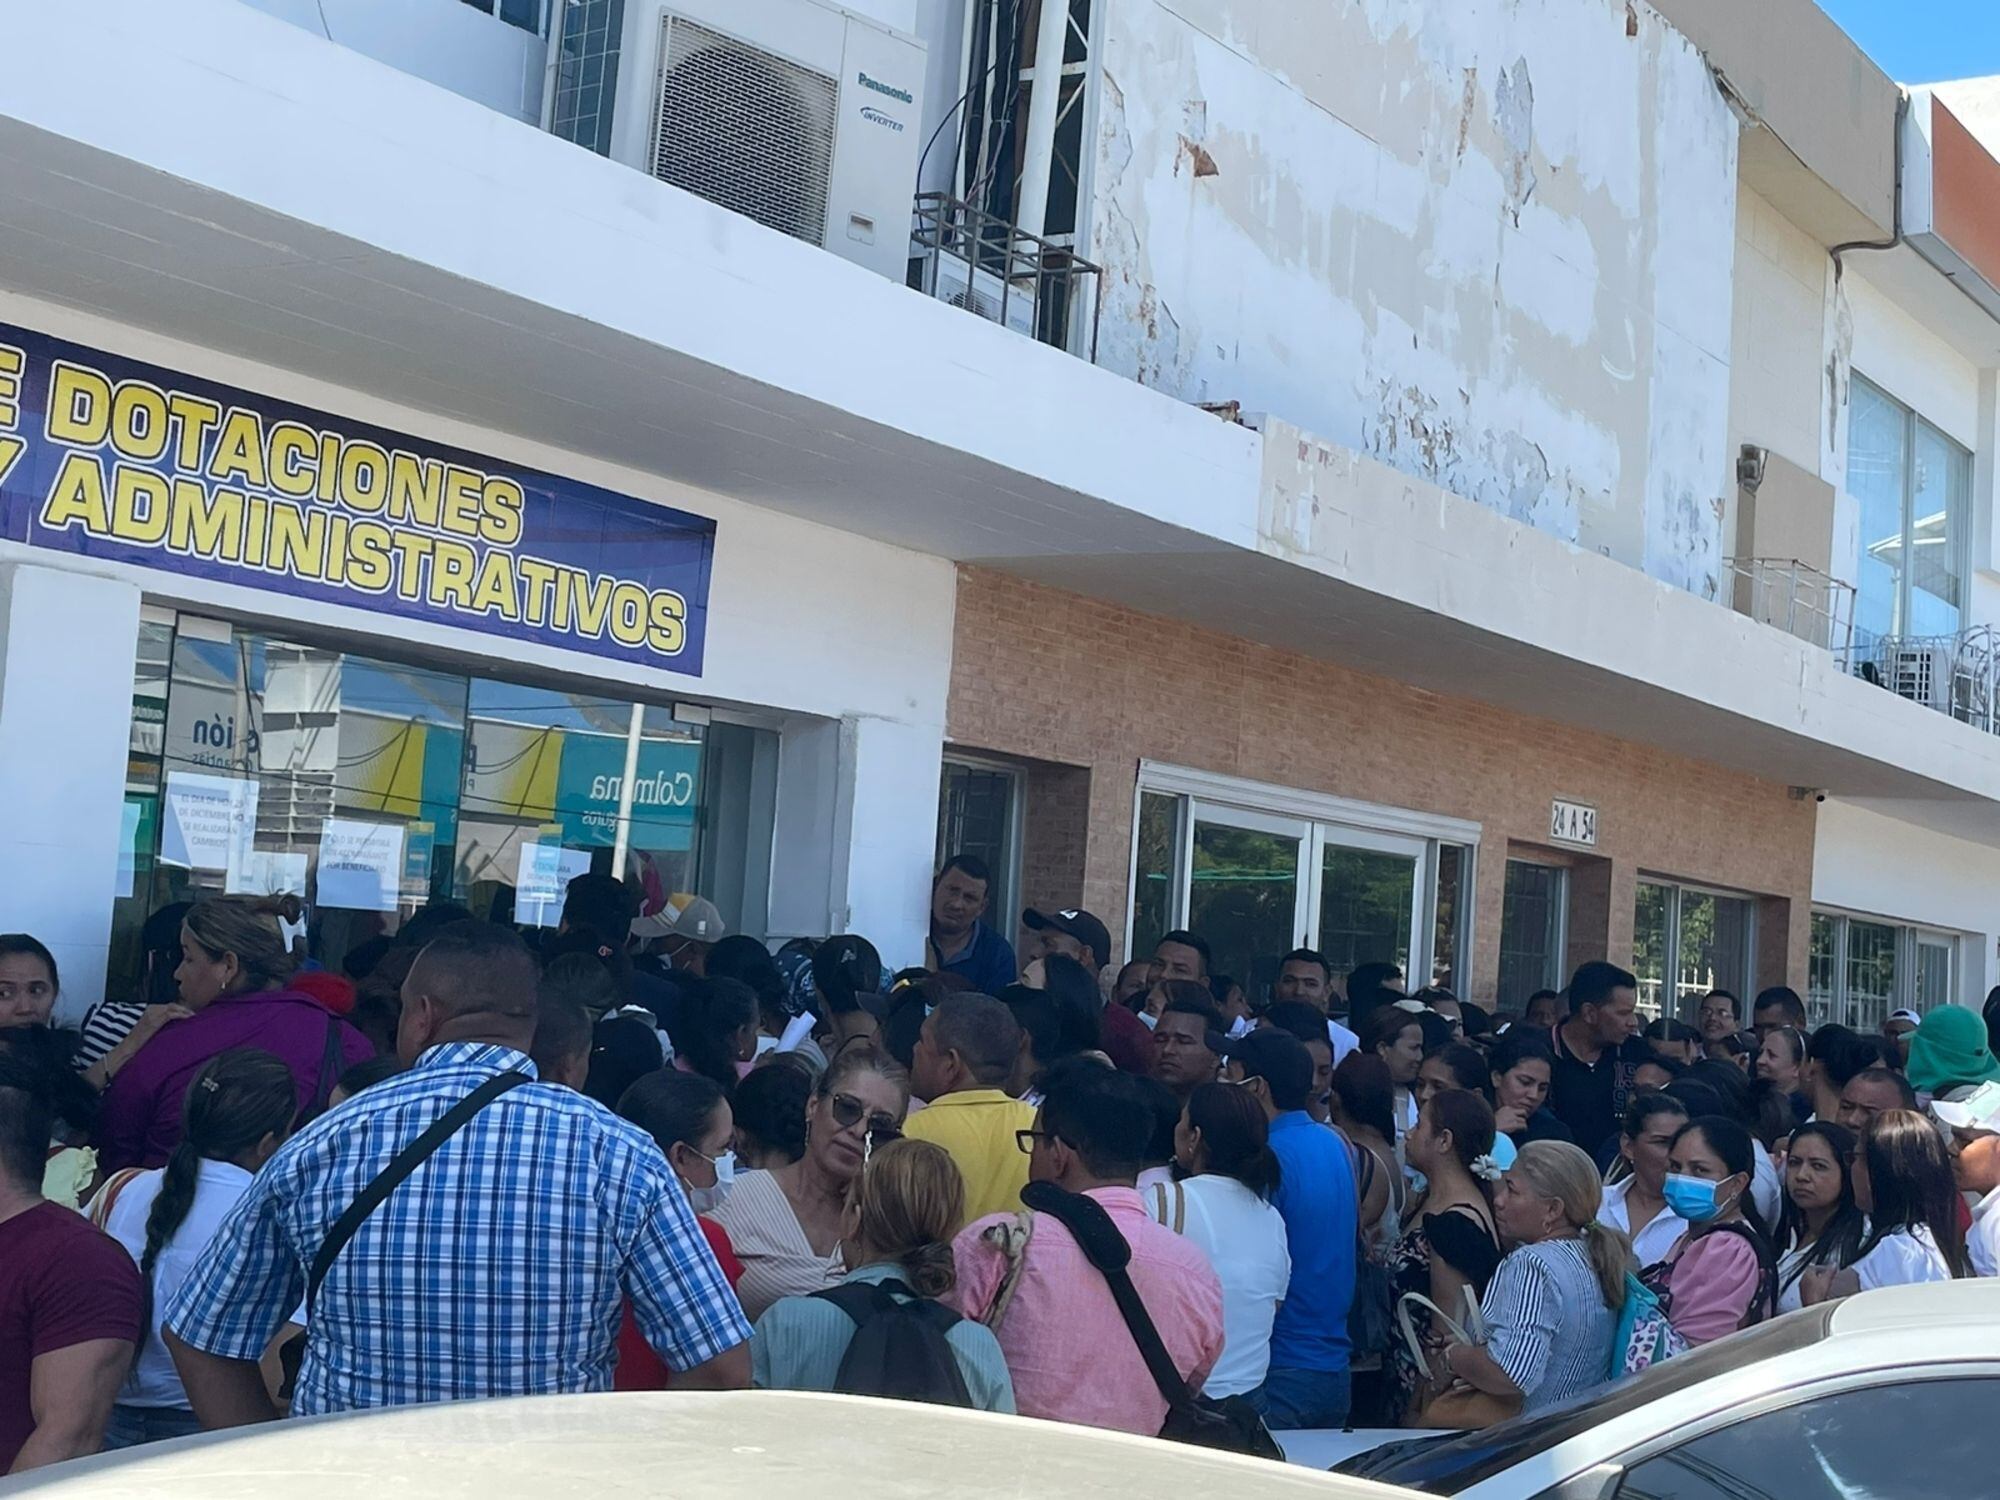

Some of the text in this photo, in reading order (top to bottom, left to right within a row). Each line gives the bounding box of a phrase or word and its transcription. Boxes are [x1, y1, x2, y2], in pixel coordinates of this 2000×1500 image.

[858, 72, 913, 104] Panasonic
[863, 110, 904, 132] INVERTER
[45, 358, 525, 546] DOTACIONES
[39, 449, 687, 656] ADMINISTRATIVOS
[1553, 804, 1594, 841] 24 A 54
